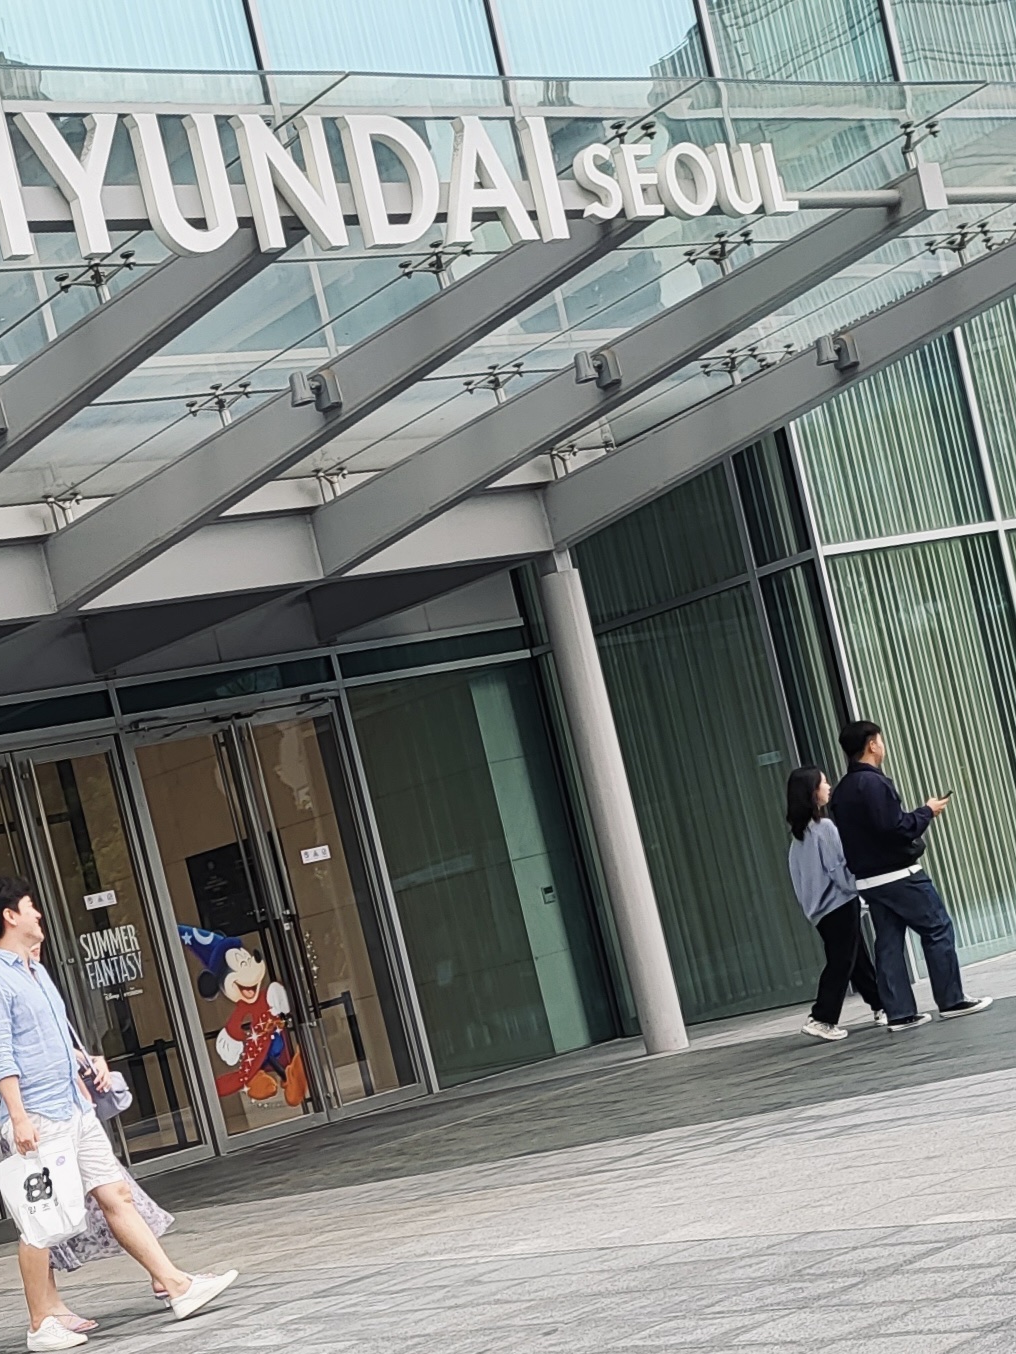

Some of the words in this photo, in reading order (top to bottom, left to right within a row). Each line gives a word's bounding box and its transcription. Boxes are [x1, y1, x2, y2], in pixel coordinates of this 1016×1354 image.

[573, 142, 799, 223] SEOUL
[80, 924, 140, 962] SUMMER
[85, 951, 143, 990] FANTASY
